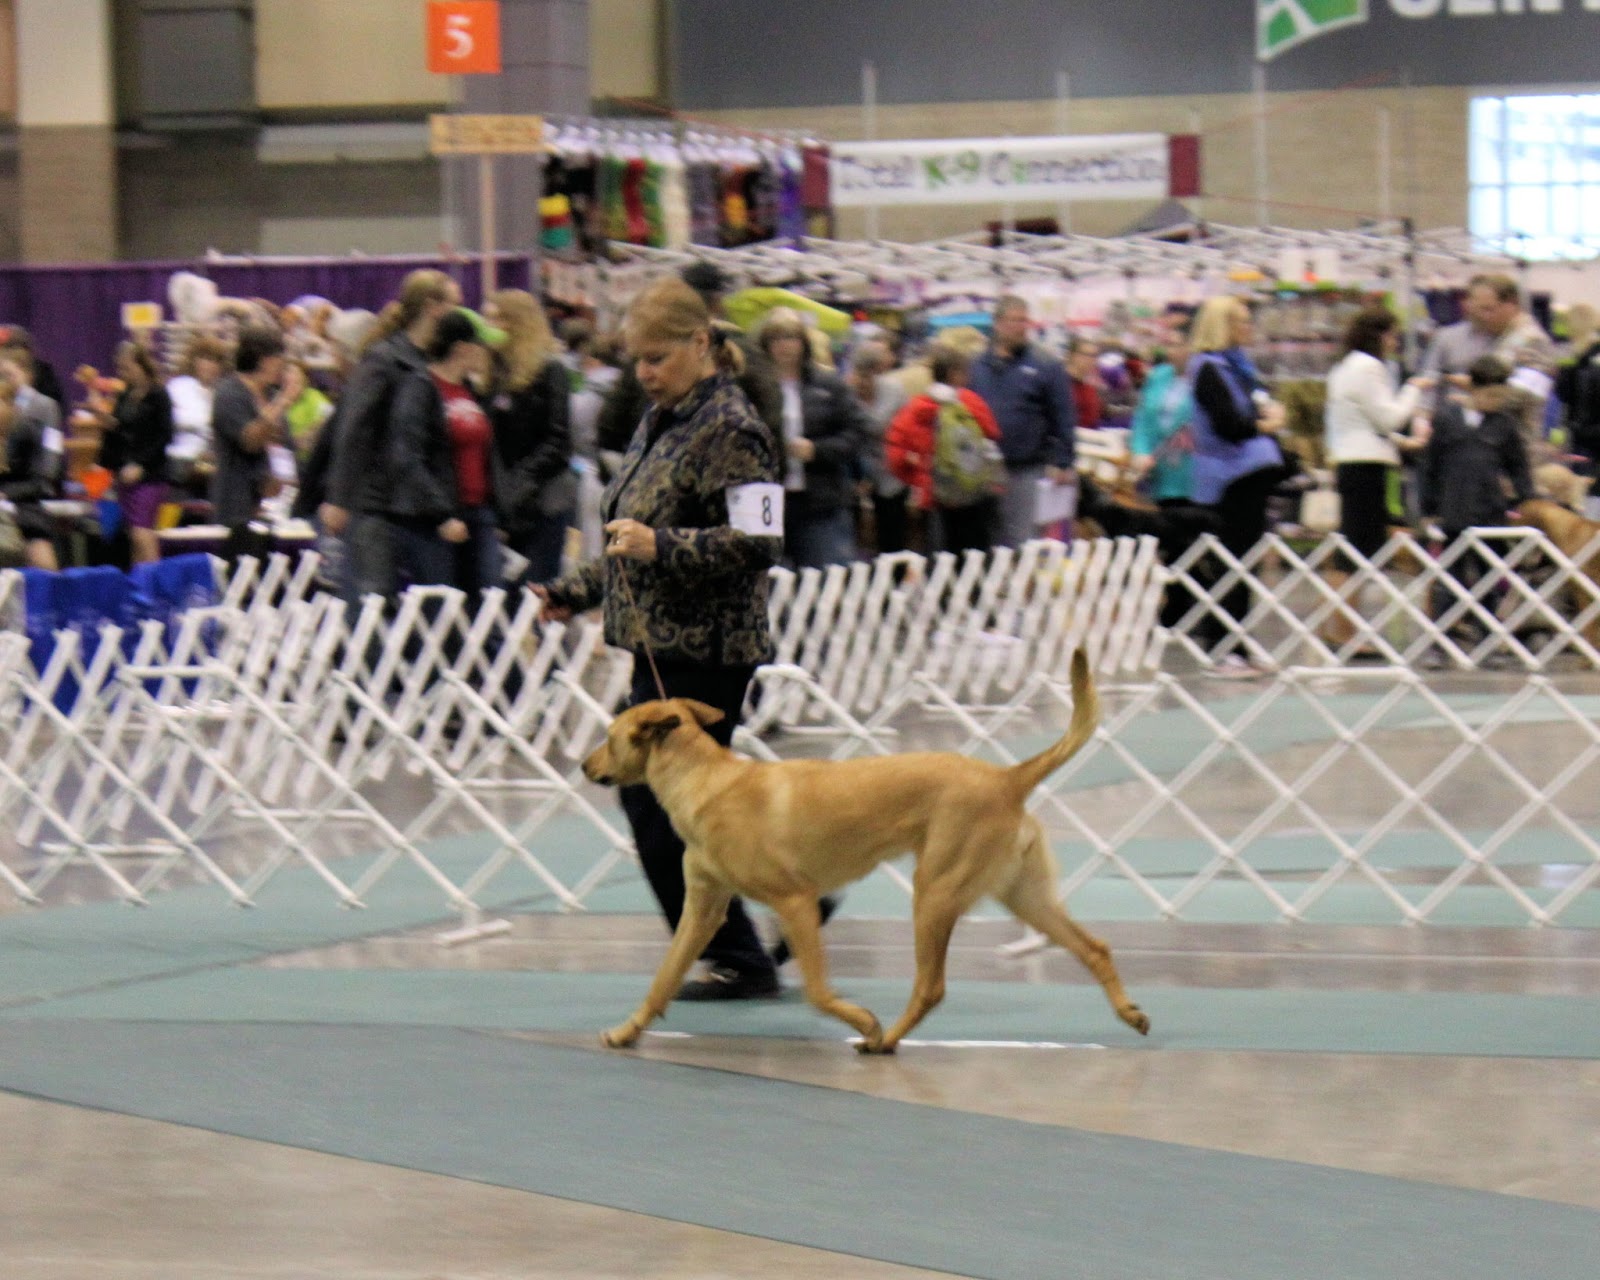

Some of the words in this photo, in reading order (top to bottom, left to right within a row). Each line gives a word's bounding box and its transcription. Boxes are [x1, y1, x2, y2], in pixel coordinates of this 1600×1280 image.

[445, 14, 474, 60] 5
[921, 150, 982, 190] K-9
[762, 495, 772, 526] 8
